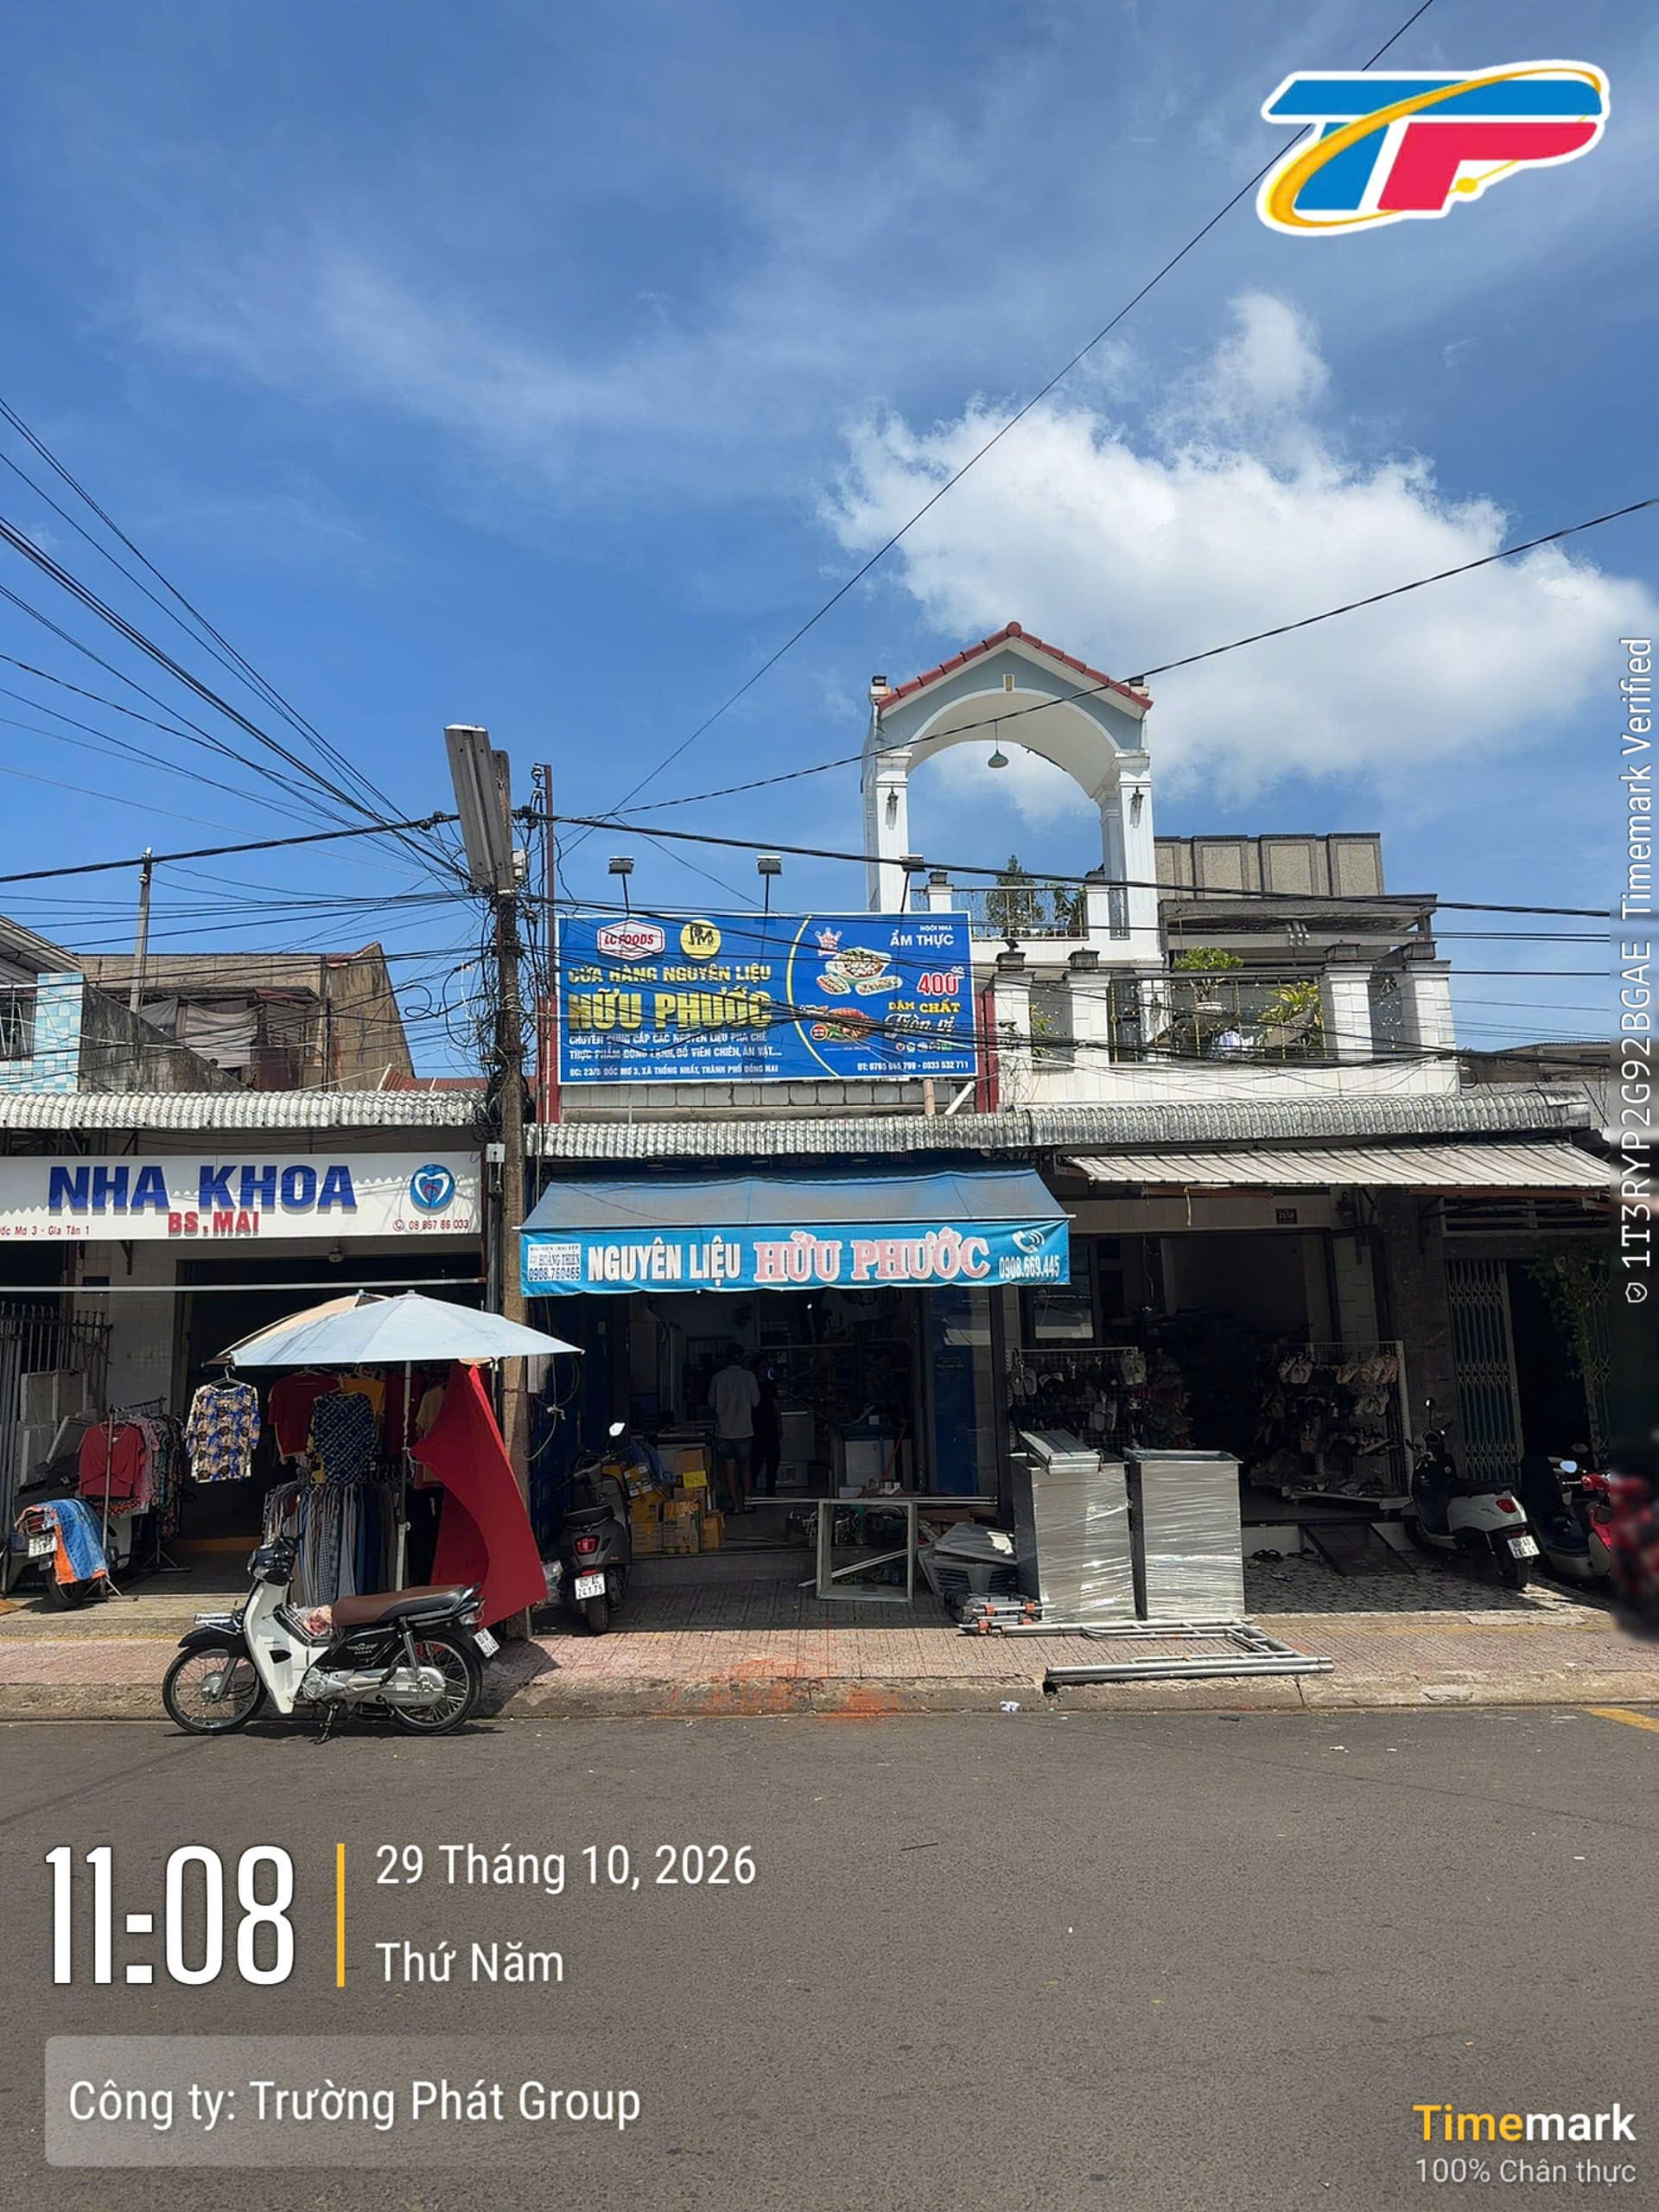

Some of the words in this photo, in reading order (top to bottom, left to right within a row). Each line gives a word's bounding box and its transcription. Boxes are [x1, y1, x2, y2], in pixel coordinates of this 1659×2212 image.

[619, 932, 654, 945] FOODS
[890, 929, 912, 947] ẨM
[916, 932, 954, 949] THỰC
[568, 964, 603, 983] CỬA
[609, 964, 658, 982] HÀNG
[663, 963, 731, 982] NGUYÊN
[735, 963, 772, 984] LIỆU
[569, 988, 642, 1029] HỮU
[654, 985, 772, 1028] PHƯỚC
[919, 998, 961, 1014] CHẤT
[632, 1031, 651, 1045] CẤP
[48, 1166, 170, 1214] NHA
[198, 1165, 358, 1214] KHOA
[0, 1225, 10, 1236] ốc
[31, 1225, 37, 1236] 3
[48, 1225, 61, 1236] Gia
[86, 1225, 90, 1235] 1
[588, 1236, 683, 1281] NGUYÊN
[690, 1235, 741, 1287] LIỆU
[753, 1230, 842, 1282] HỮU
[851, 1225, 991, 1280] PHƯỚC
